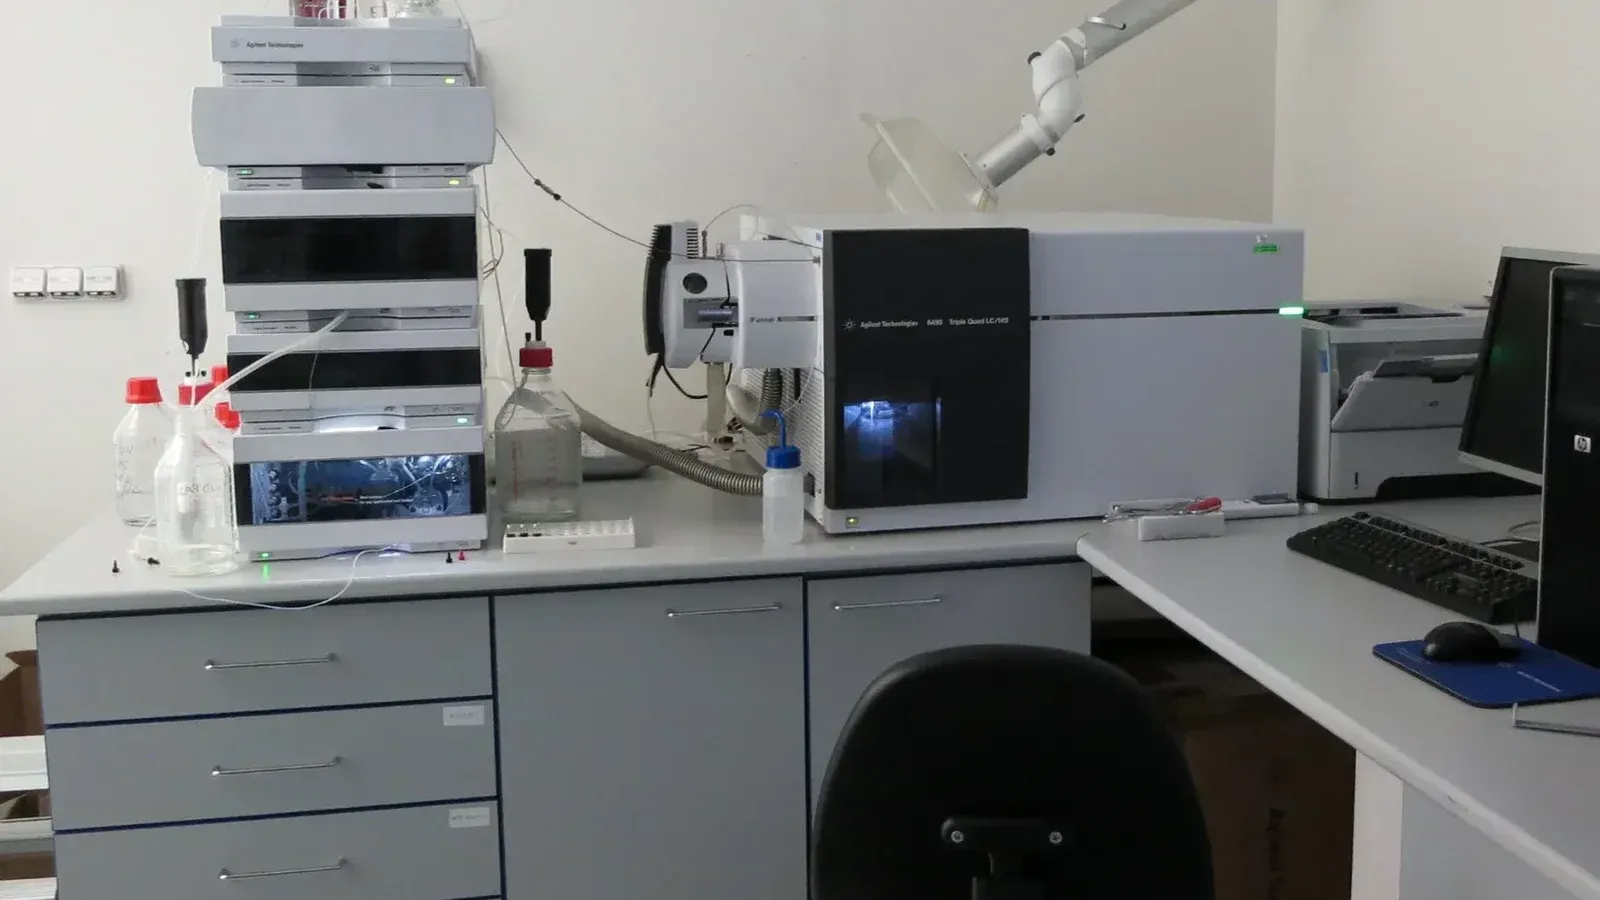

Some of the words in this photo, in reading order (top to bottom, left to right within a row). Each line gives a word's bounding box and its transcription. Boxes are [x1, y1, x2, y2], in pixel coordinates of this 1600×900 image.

[860, 321, 881, 329] Agilent
[881, 320, 918, 328] Technologies
[949, 318, 967, 327] Triple
[967, 317, 985, 325] Quad
[985, 316, 1009, 325] LC/MS
